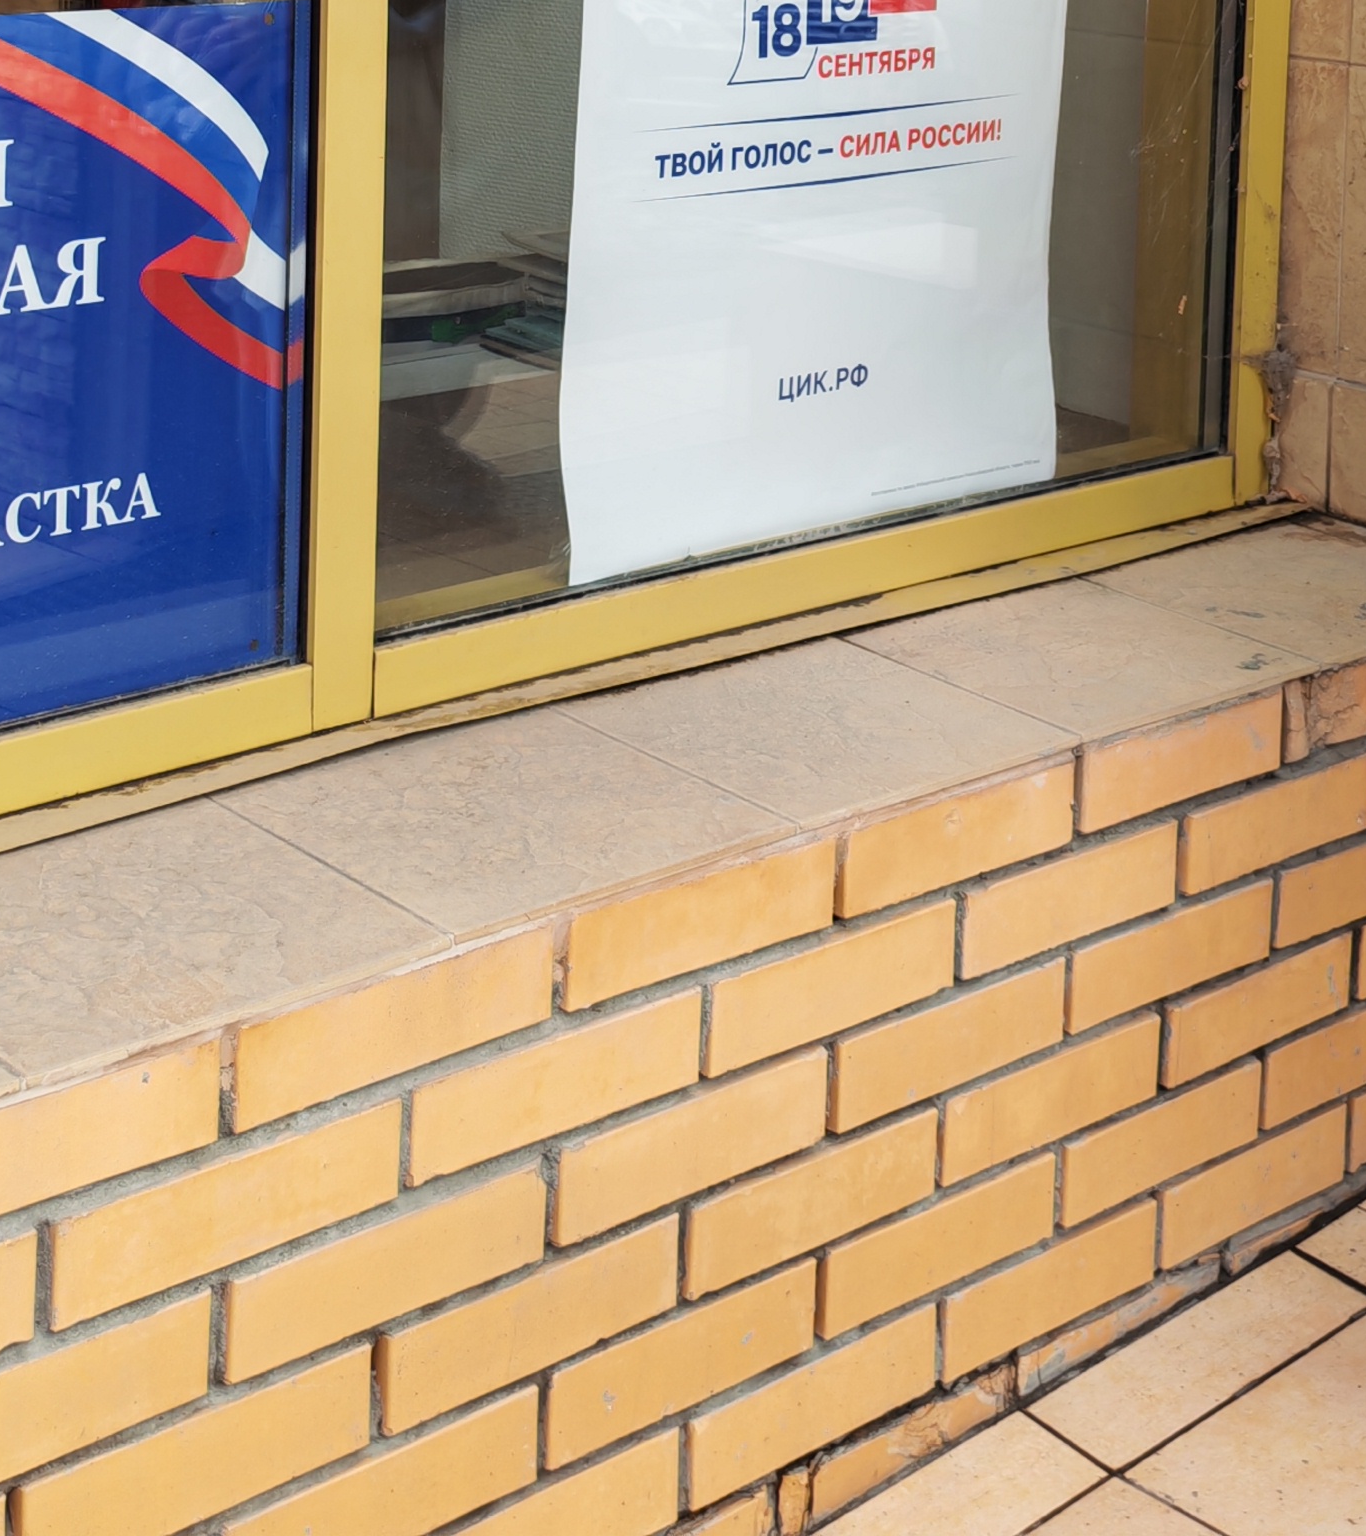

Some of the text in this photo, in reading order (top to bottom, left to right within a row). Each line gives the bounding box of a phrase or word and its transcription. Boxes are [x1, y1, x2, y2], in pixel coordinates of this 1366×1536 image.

[751, 3, 802, 59] 18
[818, 47, 936, 79] СЕНТЯБРЯ
[655, 143, 724, 178] ТВОЙ
[731, 139, 812, 171] ГОЛОС
[839, 130, 901, 159] СИЛА
[907, 119, 1002, 151] РОССИИ!
[778, 364, 868, 402] ЦИК.РФ
